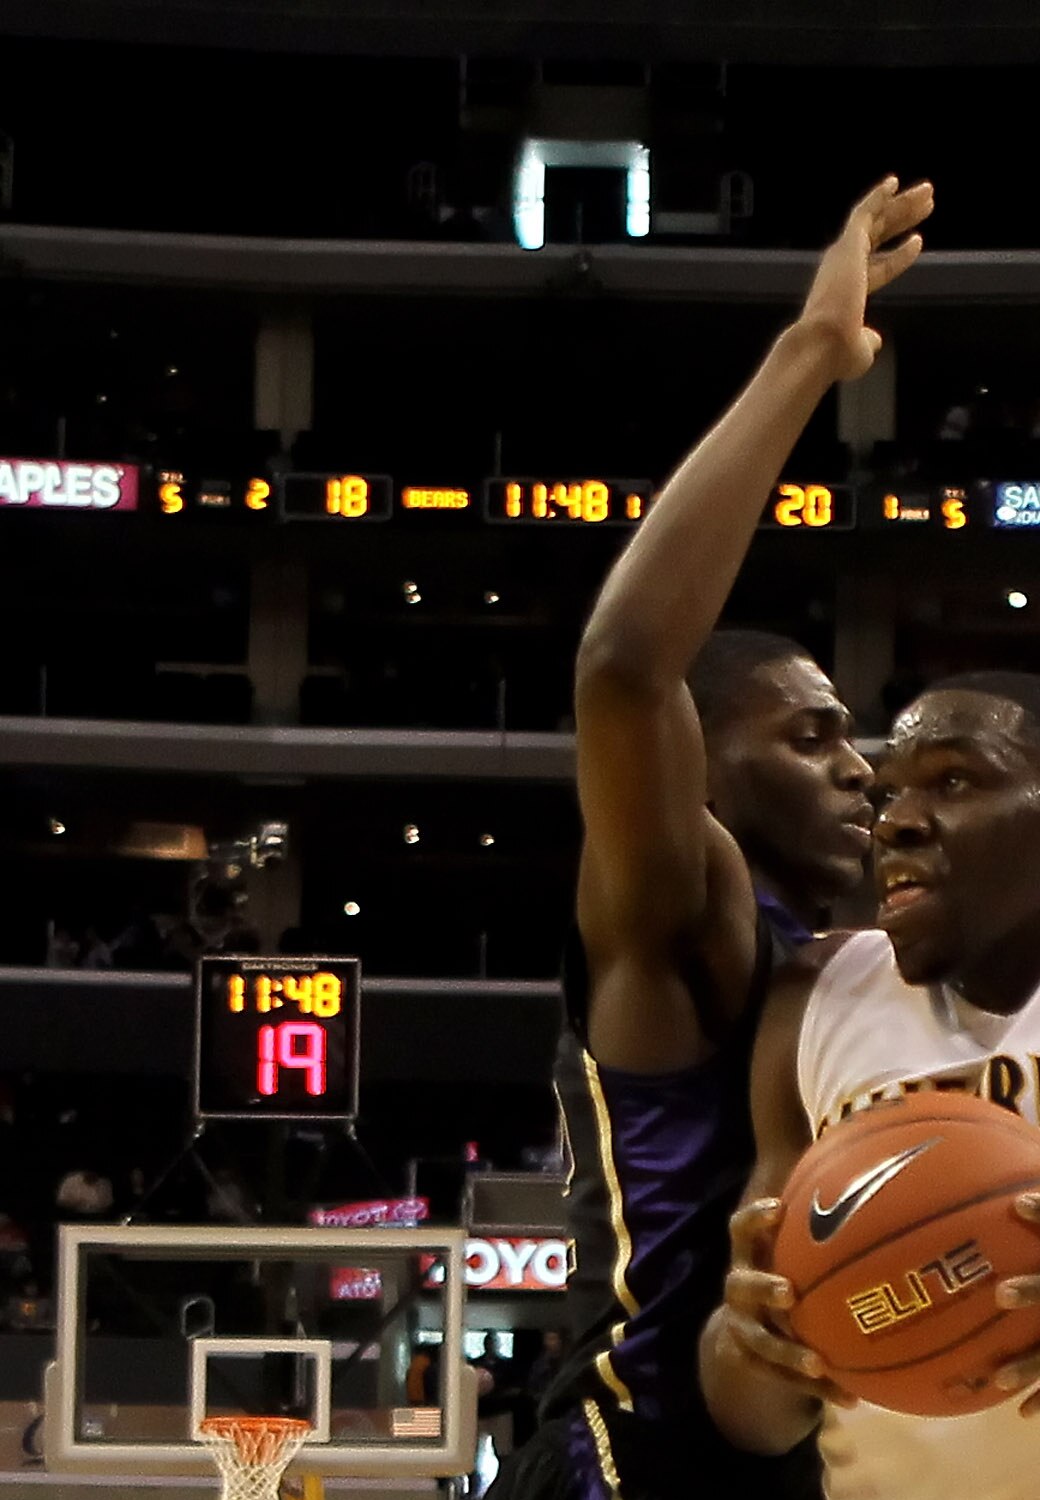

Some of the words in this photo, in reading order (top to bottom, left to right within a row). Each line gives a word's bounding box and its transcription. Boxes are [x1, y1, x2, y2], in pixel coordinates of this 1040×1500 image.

[160, 482, 183, 513] 5
[246, 478, 270, 510] 2
[326, 476, 369, 518] 18
[408, 490, 469, 508] BEARS
[505, 480, 608, 521] 11:48
[775, 484, 832, 526] 20
[942, 498, 967, 529] 5
[228, 973, 342, 1018] 11:48
[258, 1022, 327, 1096] 19
[462, 1239, 567, 1286] OYO
[846, 1239, 994, 1334] ELITE
